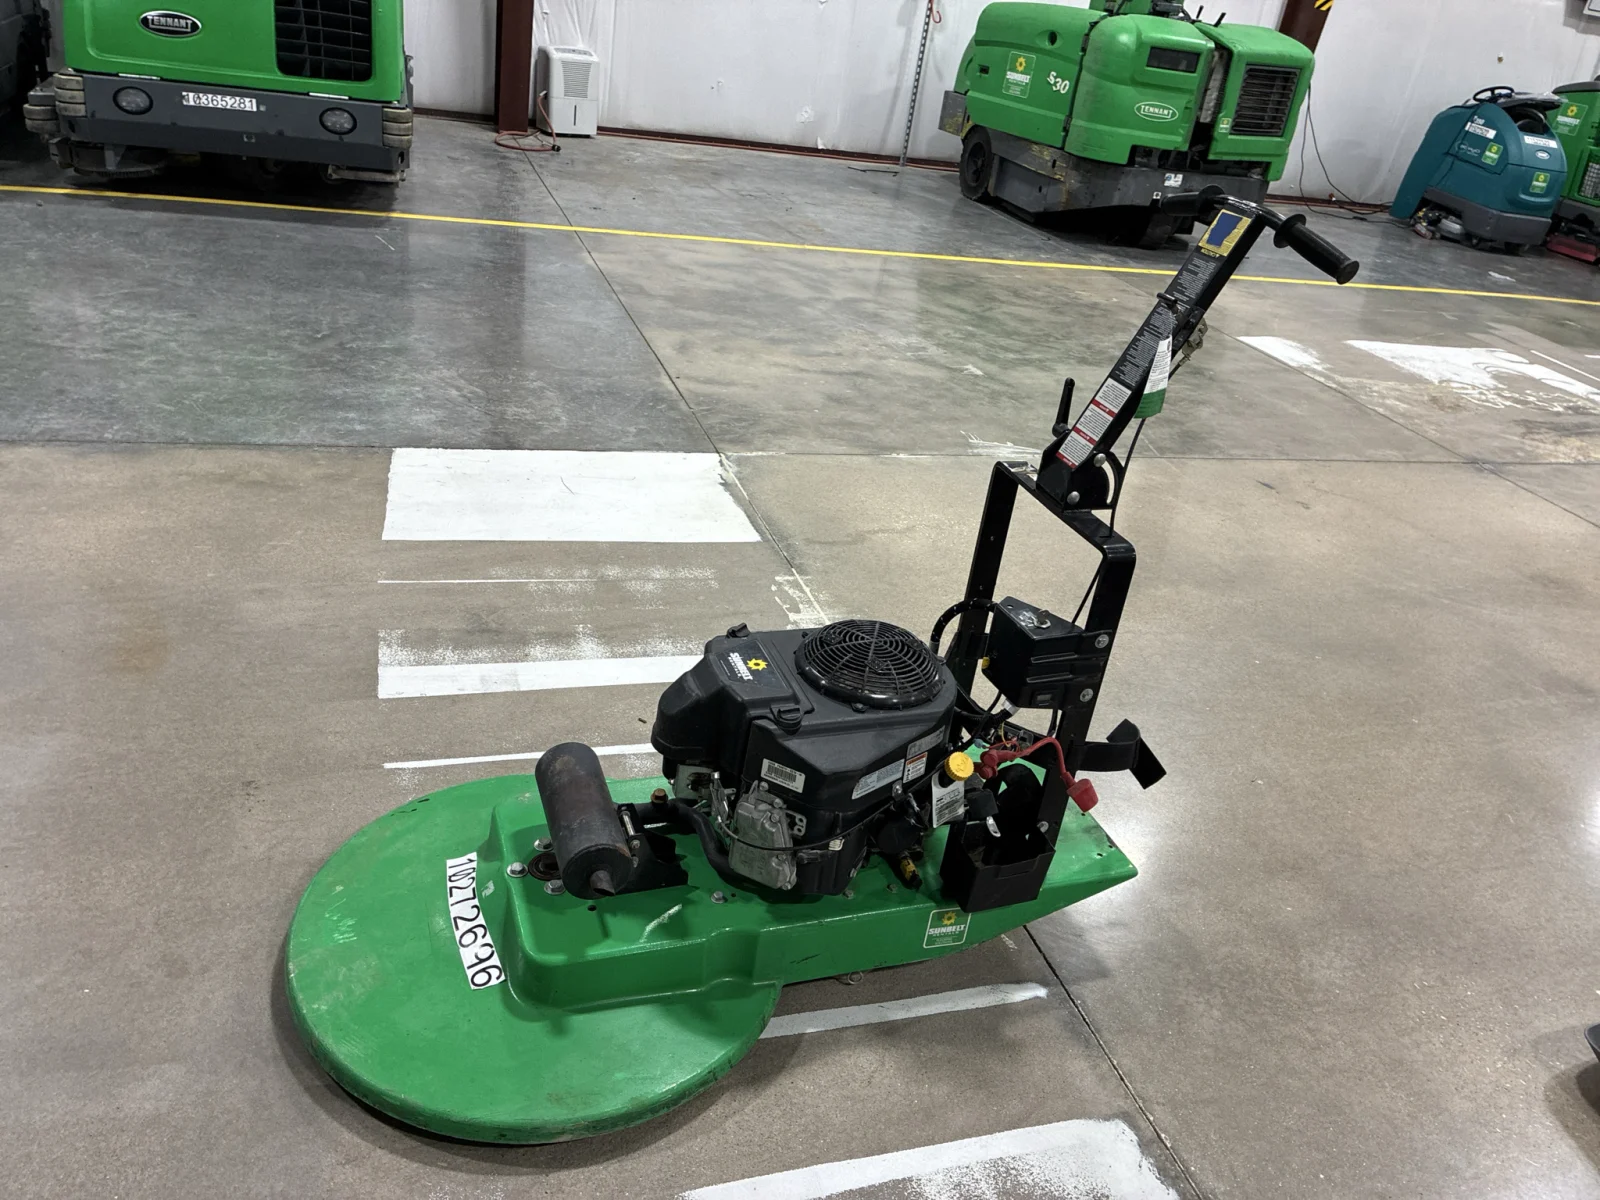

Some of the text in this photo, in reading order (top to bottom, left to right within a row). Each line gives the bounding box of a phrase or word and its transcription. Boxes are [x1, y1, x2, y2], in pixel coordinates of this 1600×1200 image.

[147, 15, 192, 32] TENNANT
[1047, 71, 1070, 94] S30
[182, 92, 256, 111] 10365281
[1141, 105, 1173, 118] TENNANT
[729, 652, 753, 680] SUNBELT
[447, 858, 503, 987] 10272696
[928, 924, 966, 935] SUNBELT
